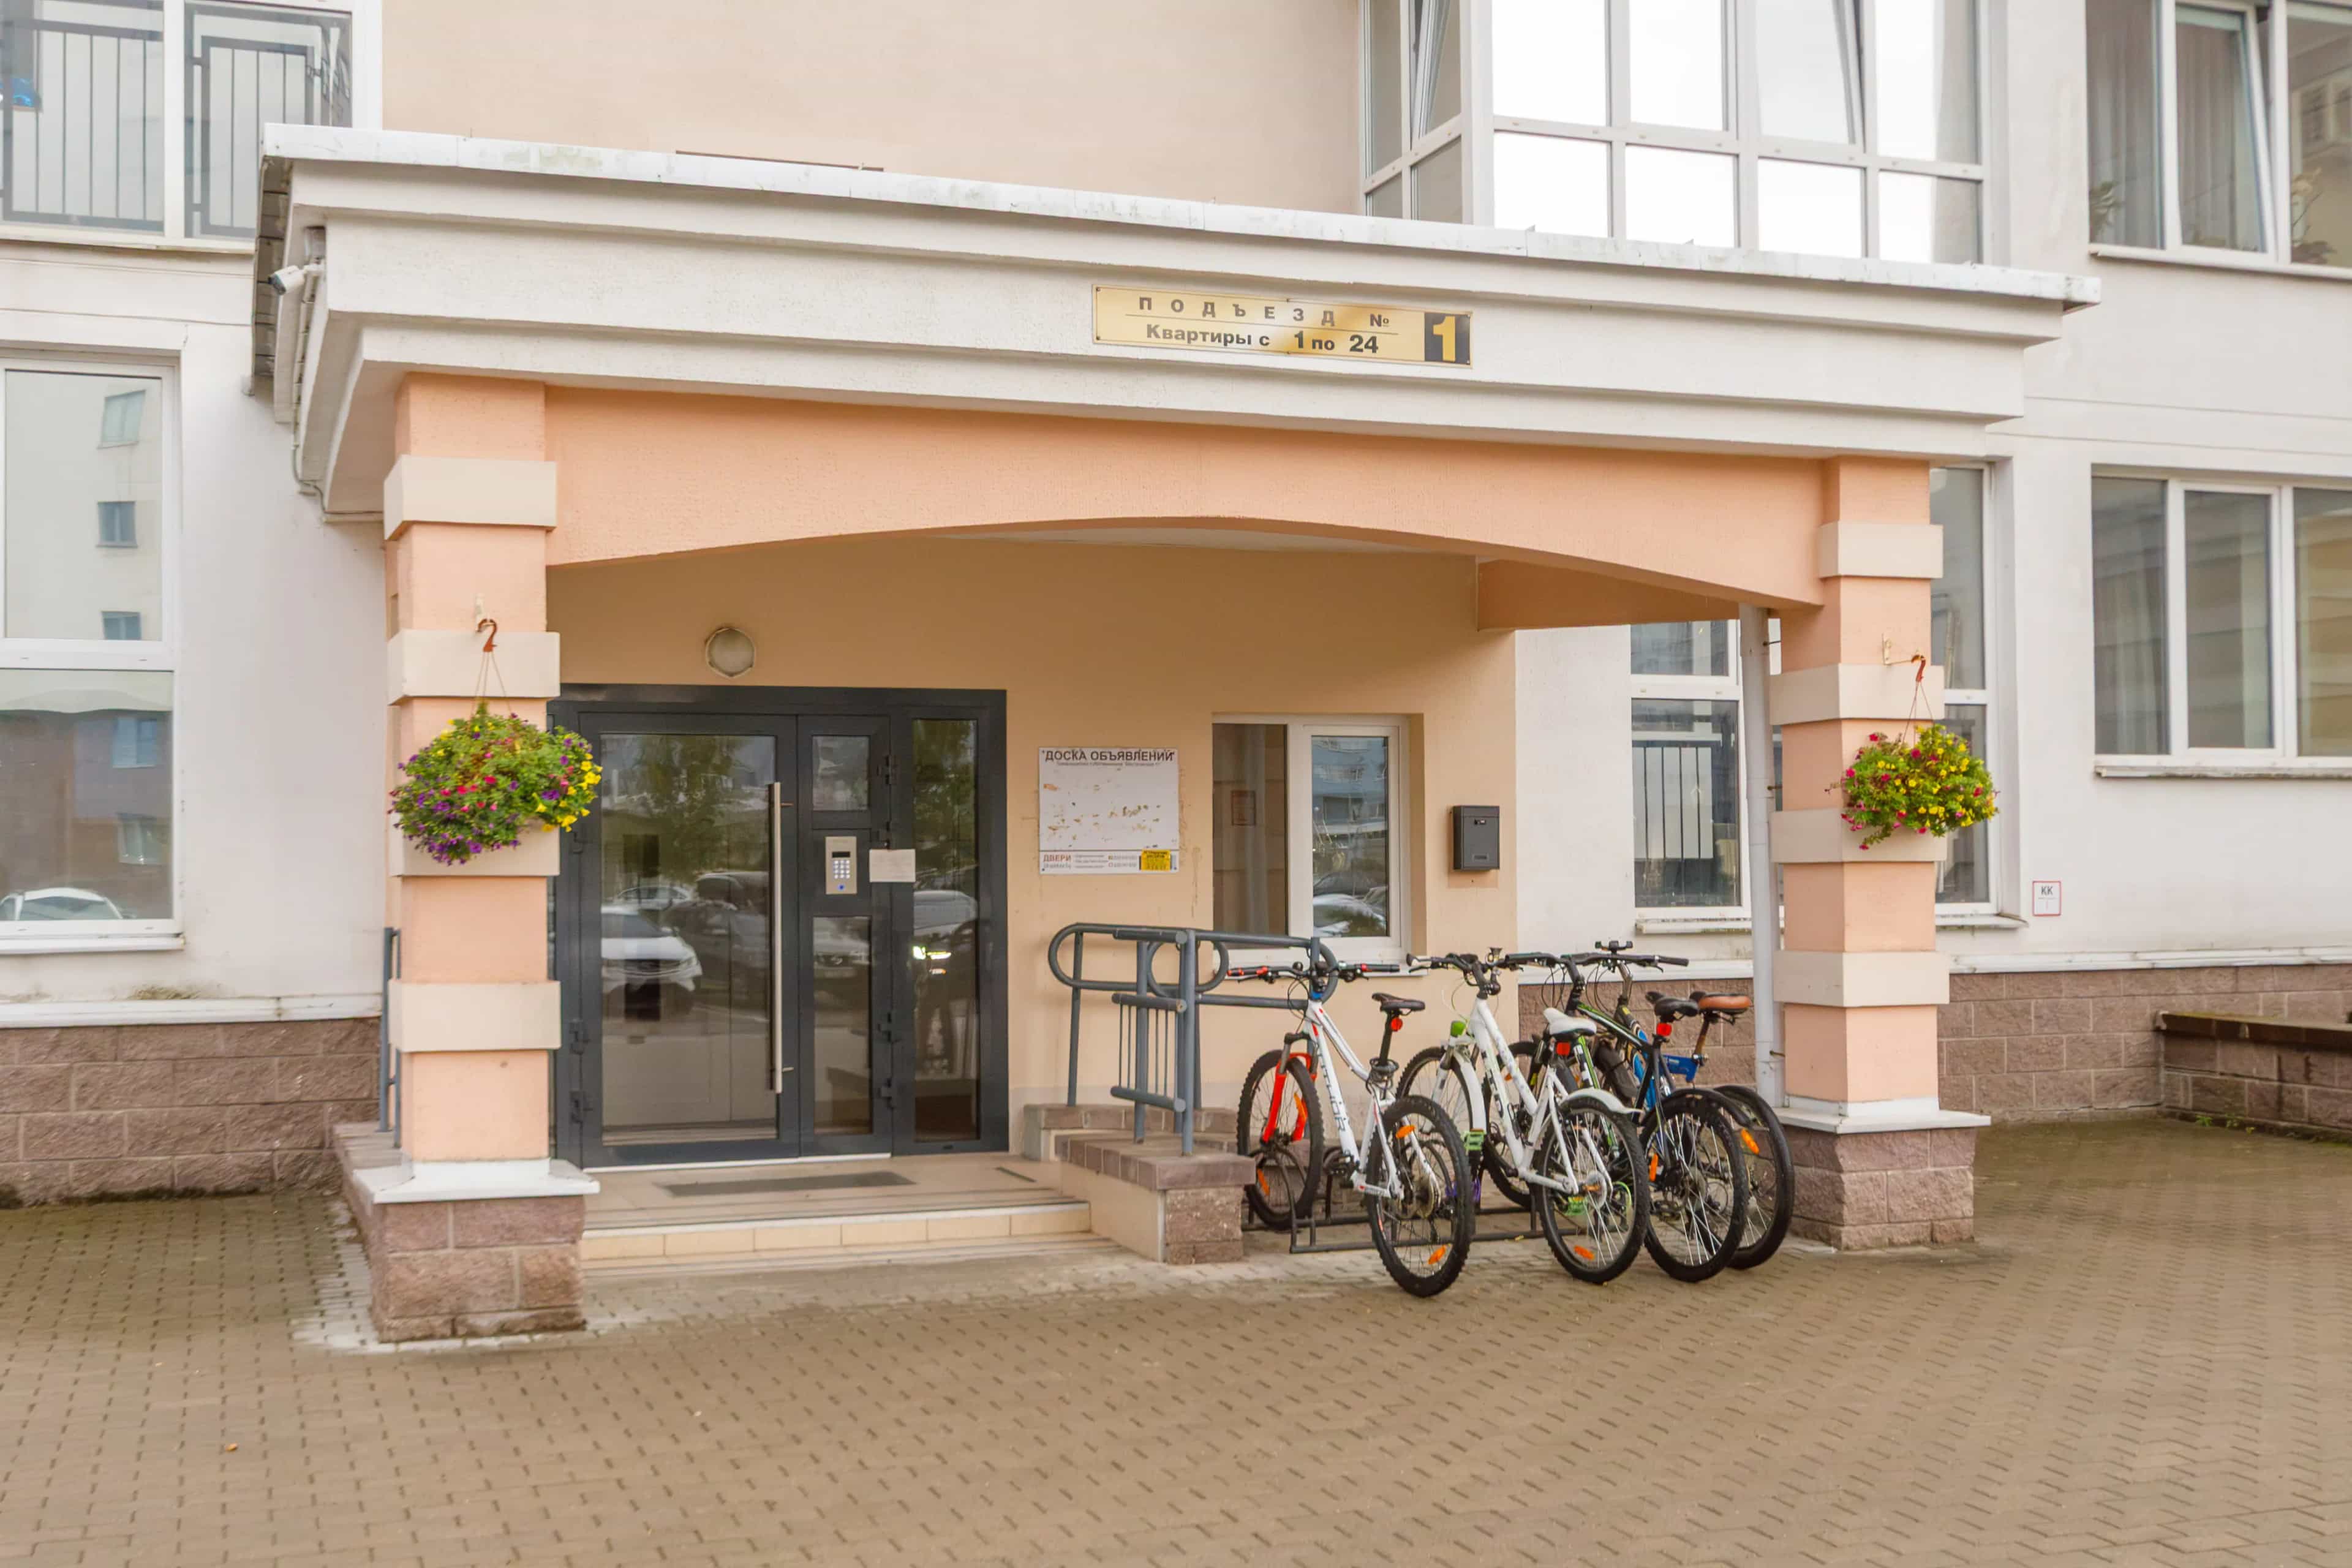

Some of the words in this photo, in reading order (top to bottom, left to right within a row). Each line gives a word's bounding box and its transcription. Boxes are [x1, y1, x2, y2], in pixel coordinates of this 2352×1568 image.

[1139, 296, 1335, 327] ПОДЪЕЗД
[1433, 315, 1457, 363] 1
[1147, 324, 1251, 347] Квартиры
[1259, 334, 1270, 347] с
[1294, 332, 1304, 349] 1
[1312, 337, 1336, 351] по
[1349, 334, 1379, 353] 24
[1045, 750, 1087, 761] ДОСКА
[1090, 749, 1175, 761] ОБЪЯВЛЕНИЙ
